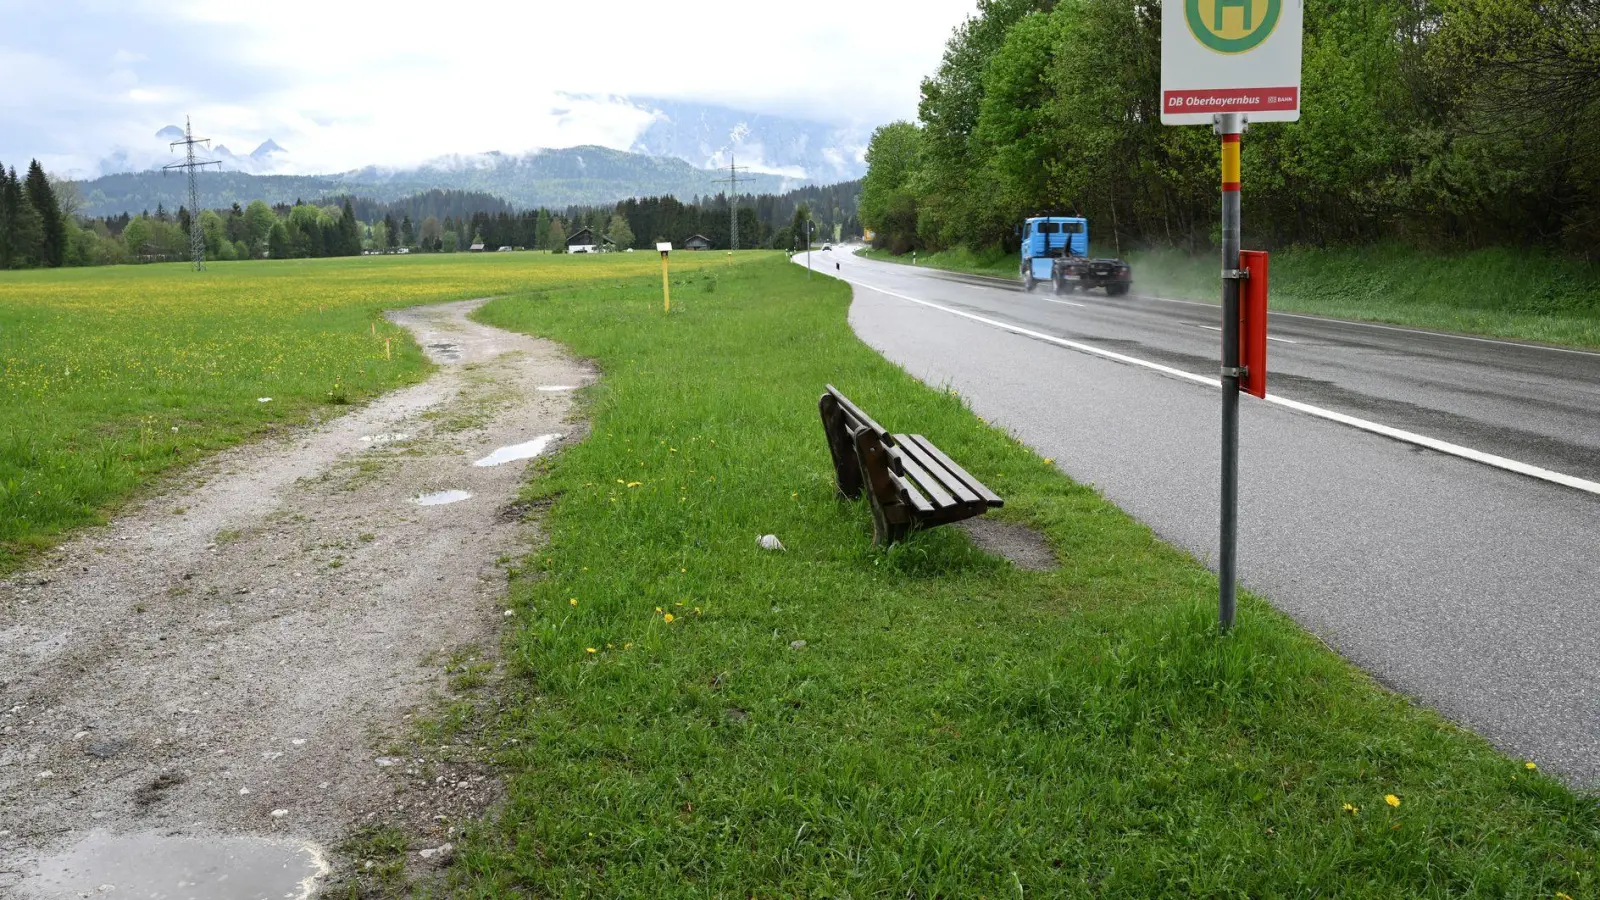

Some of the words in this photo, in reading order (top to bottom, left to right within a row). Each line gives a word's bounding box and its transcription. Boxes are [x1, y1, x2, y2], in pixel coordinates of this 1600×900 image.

[1214, 0, 1252, 31] H
[1168, 97, 1183, 107] DB
[1185, 95, 1260, 107] Oberbayernbus
